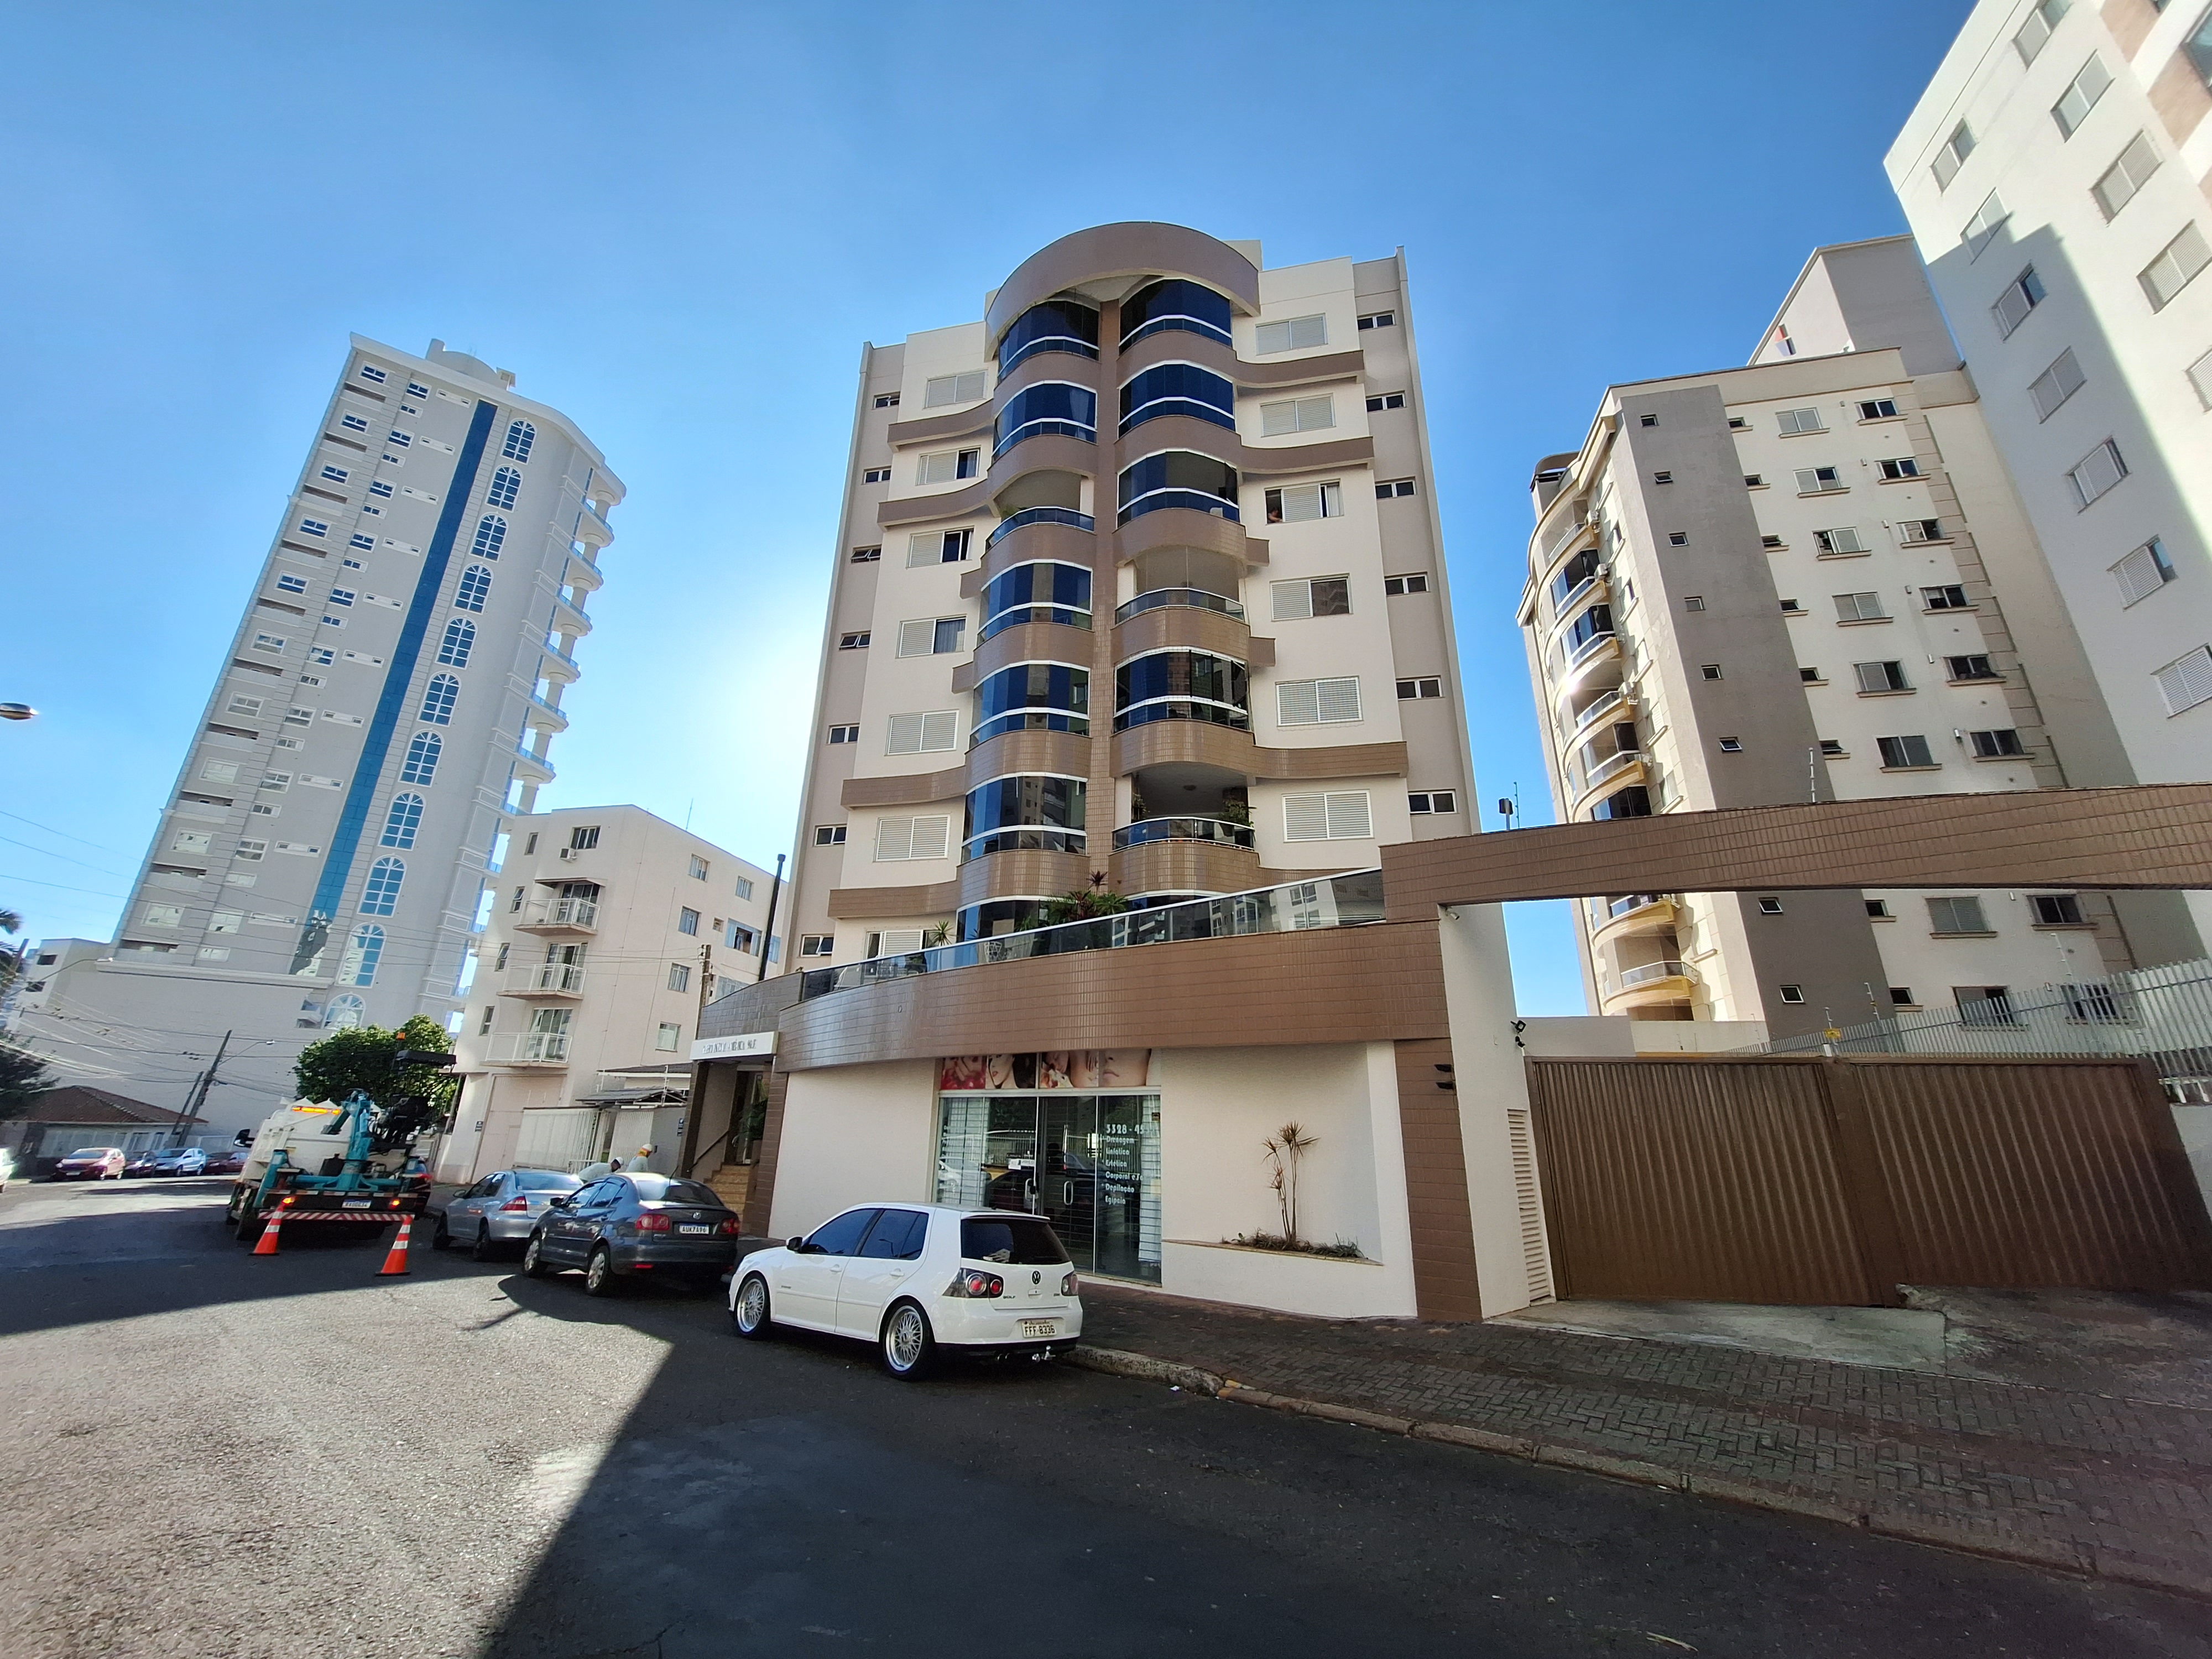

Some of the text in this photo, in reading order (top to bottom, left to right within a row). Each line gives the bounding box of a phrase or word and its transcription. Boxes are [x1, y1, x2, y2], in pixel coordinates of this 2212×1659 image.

[1106, 1124, 1127, 1134] 3328
[1106, 1136, 1135, 1145] Drenagem
[1105, 1171, 1130, 1181] Corporal
[1105, 1183, 1135, 1193] Depilação
